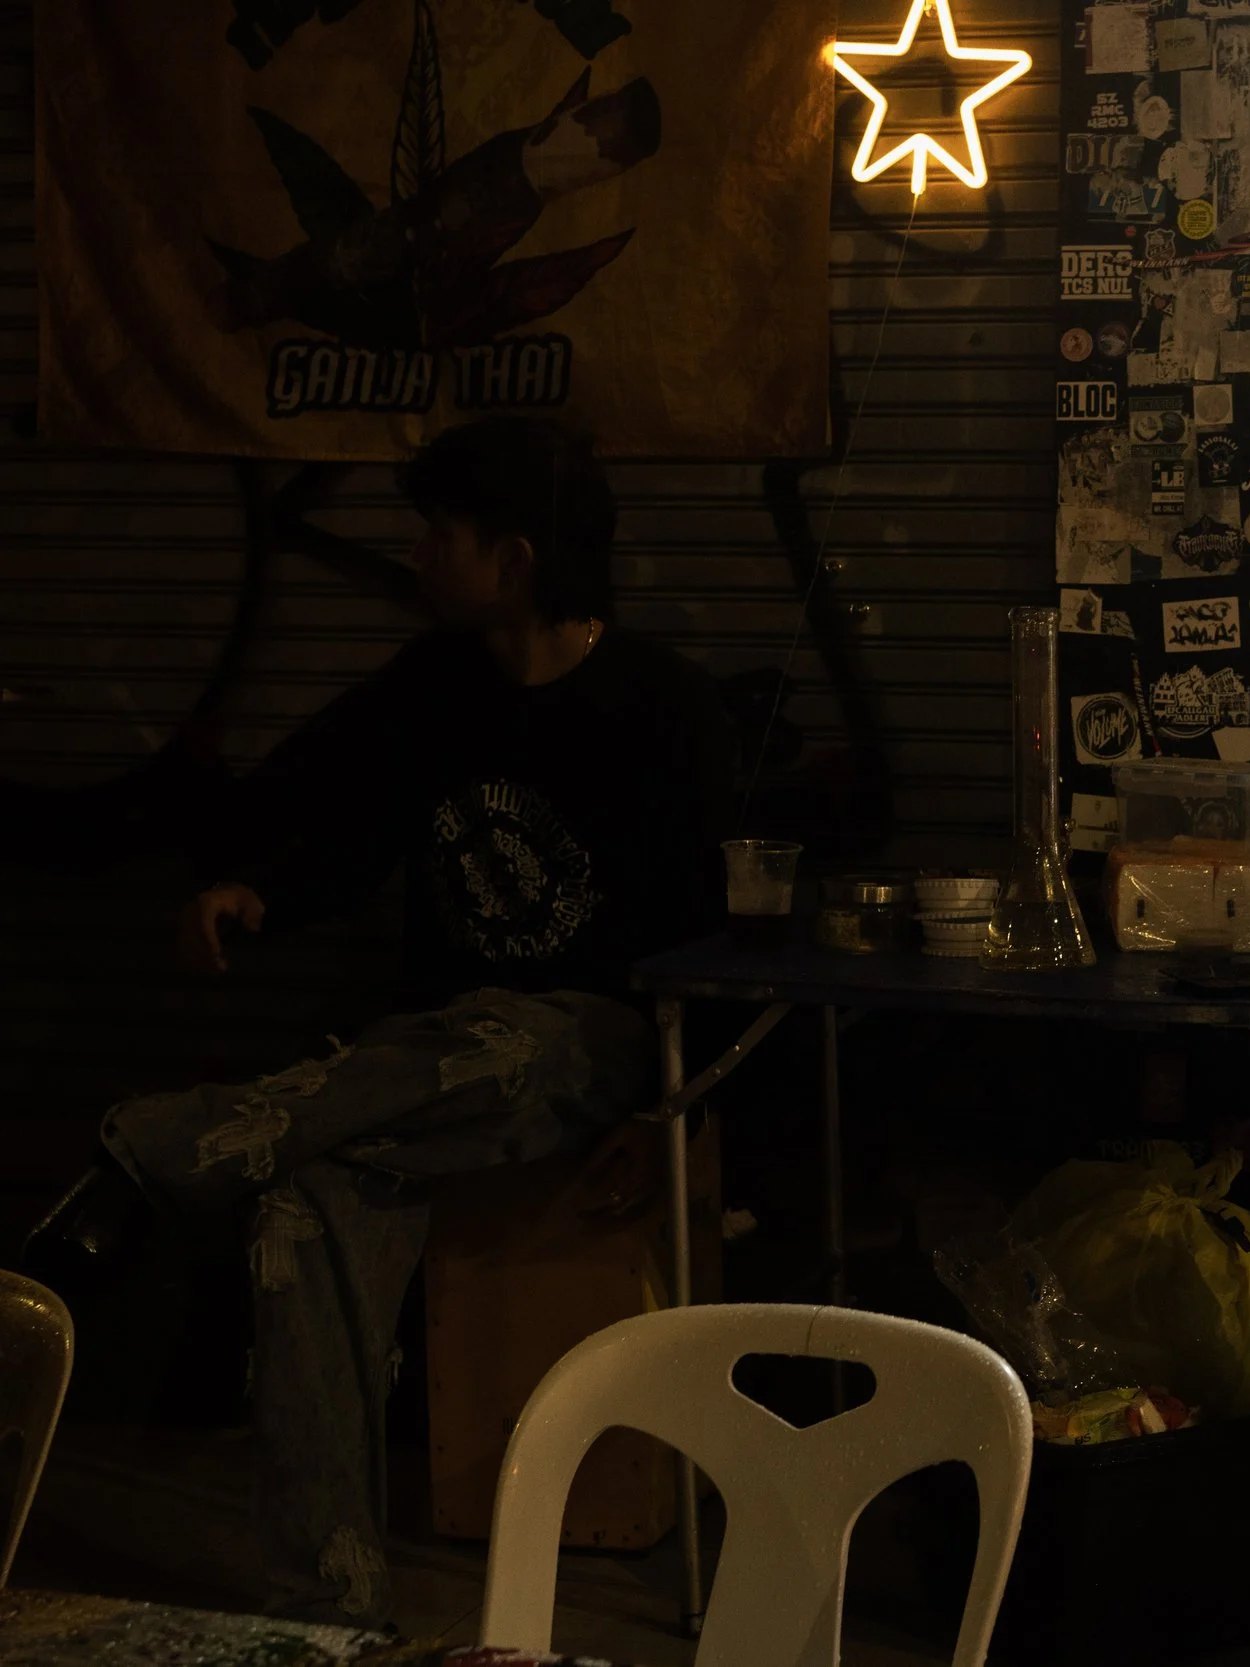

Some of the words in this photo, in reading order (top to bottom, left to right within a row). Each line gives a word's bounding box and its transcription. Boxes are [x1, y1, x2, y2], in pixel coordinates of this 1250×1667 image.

[1090, 104, 1125, 115] RMC
[1087, 116, 1129, 129] 4203
[1061, 278, 1093, 294] TCS
[1097, 278, 1132, 294] NUL
[269, 339, 437, 416] GANJA
[452, 336, 570, 408] THAI
[1058, 384, 1115, 418] BLOC
